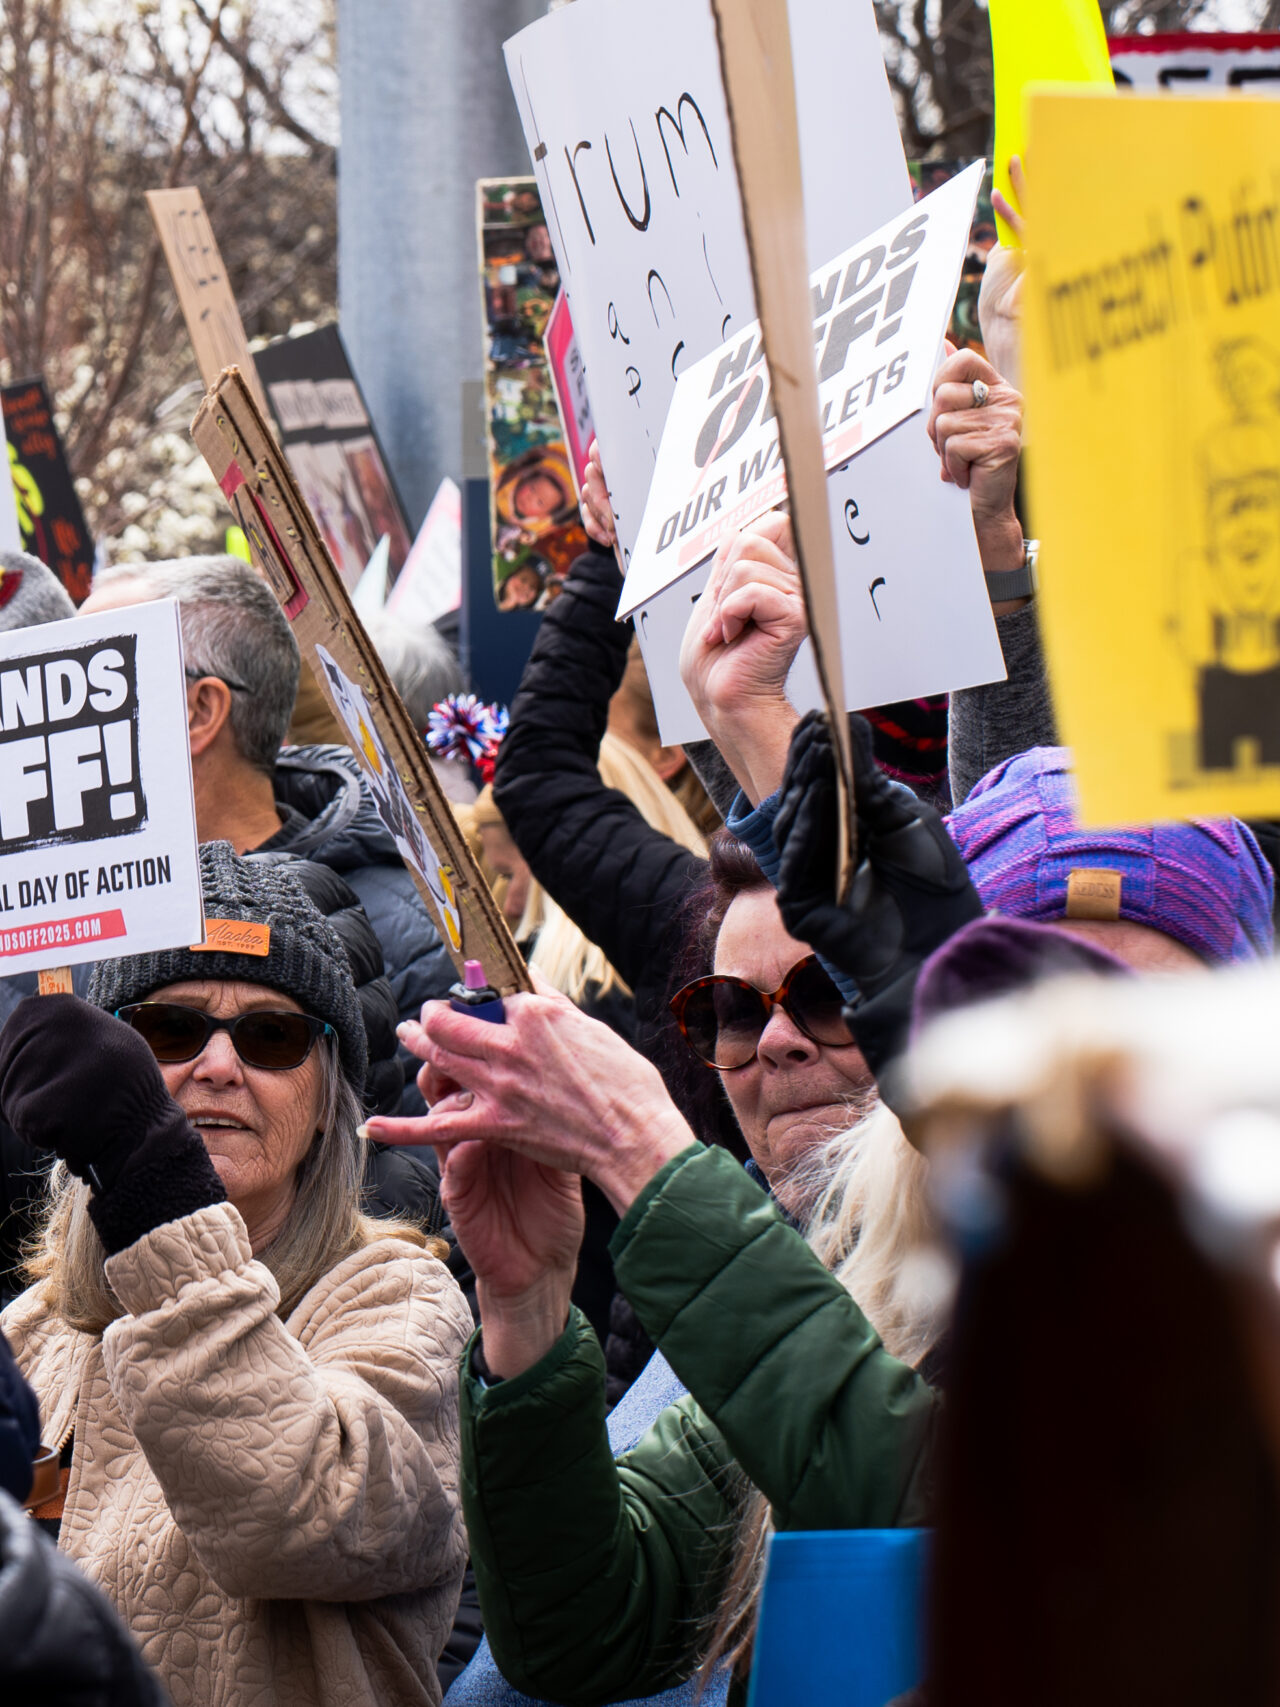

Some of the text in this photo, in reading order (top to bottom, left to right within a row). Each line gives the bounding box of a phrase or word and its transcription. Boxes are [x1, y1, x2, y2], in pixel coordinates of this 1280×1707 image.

[656, 475, 728, 555] OUR
[18, 875, 58, 908] DAY
[65, 870, 89, 900] OF
[97, 855, 171, 895] ACTION
[207, 921, 264, 944] Alaska
